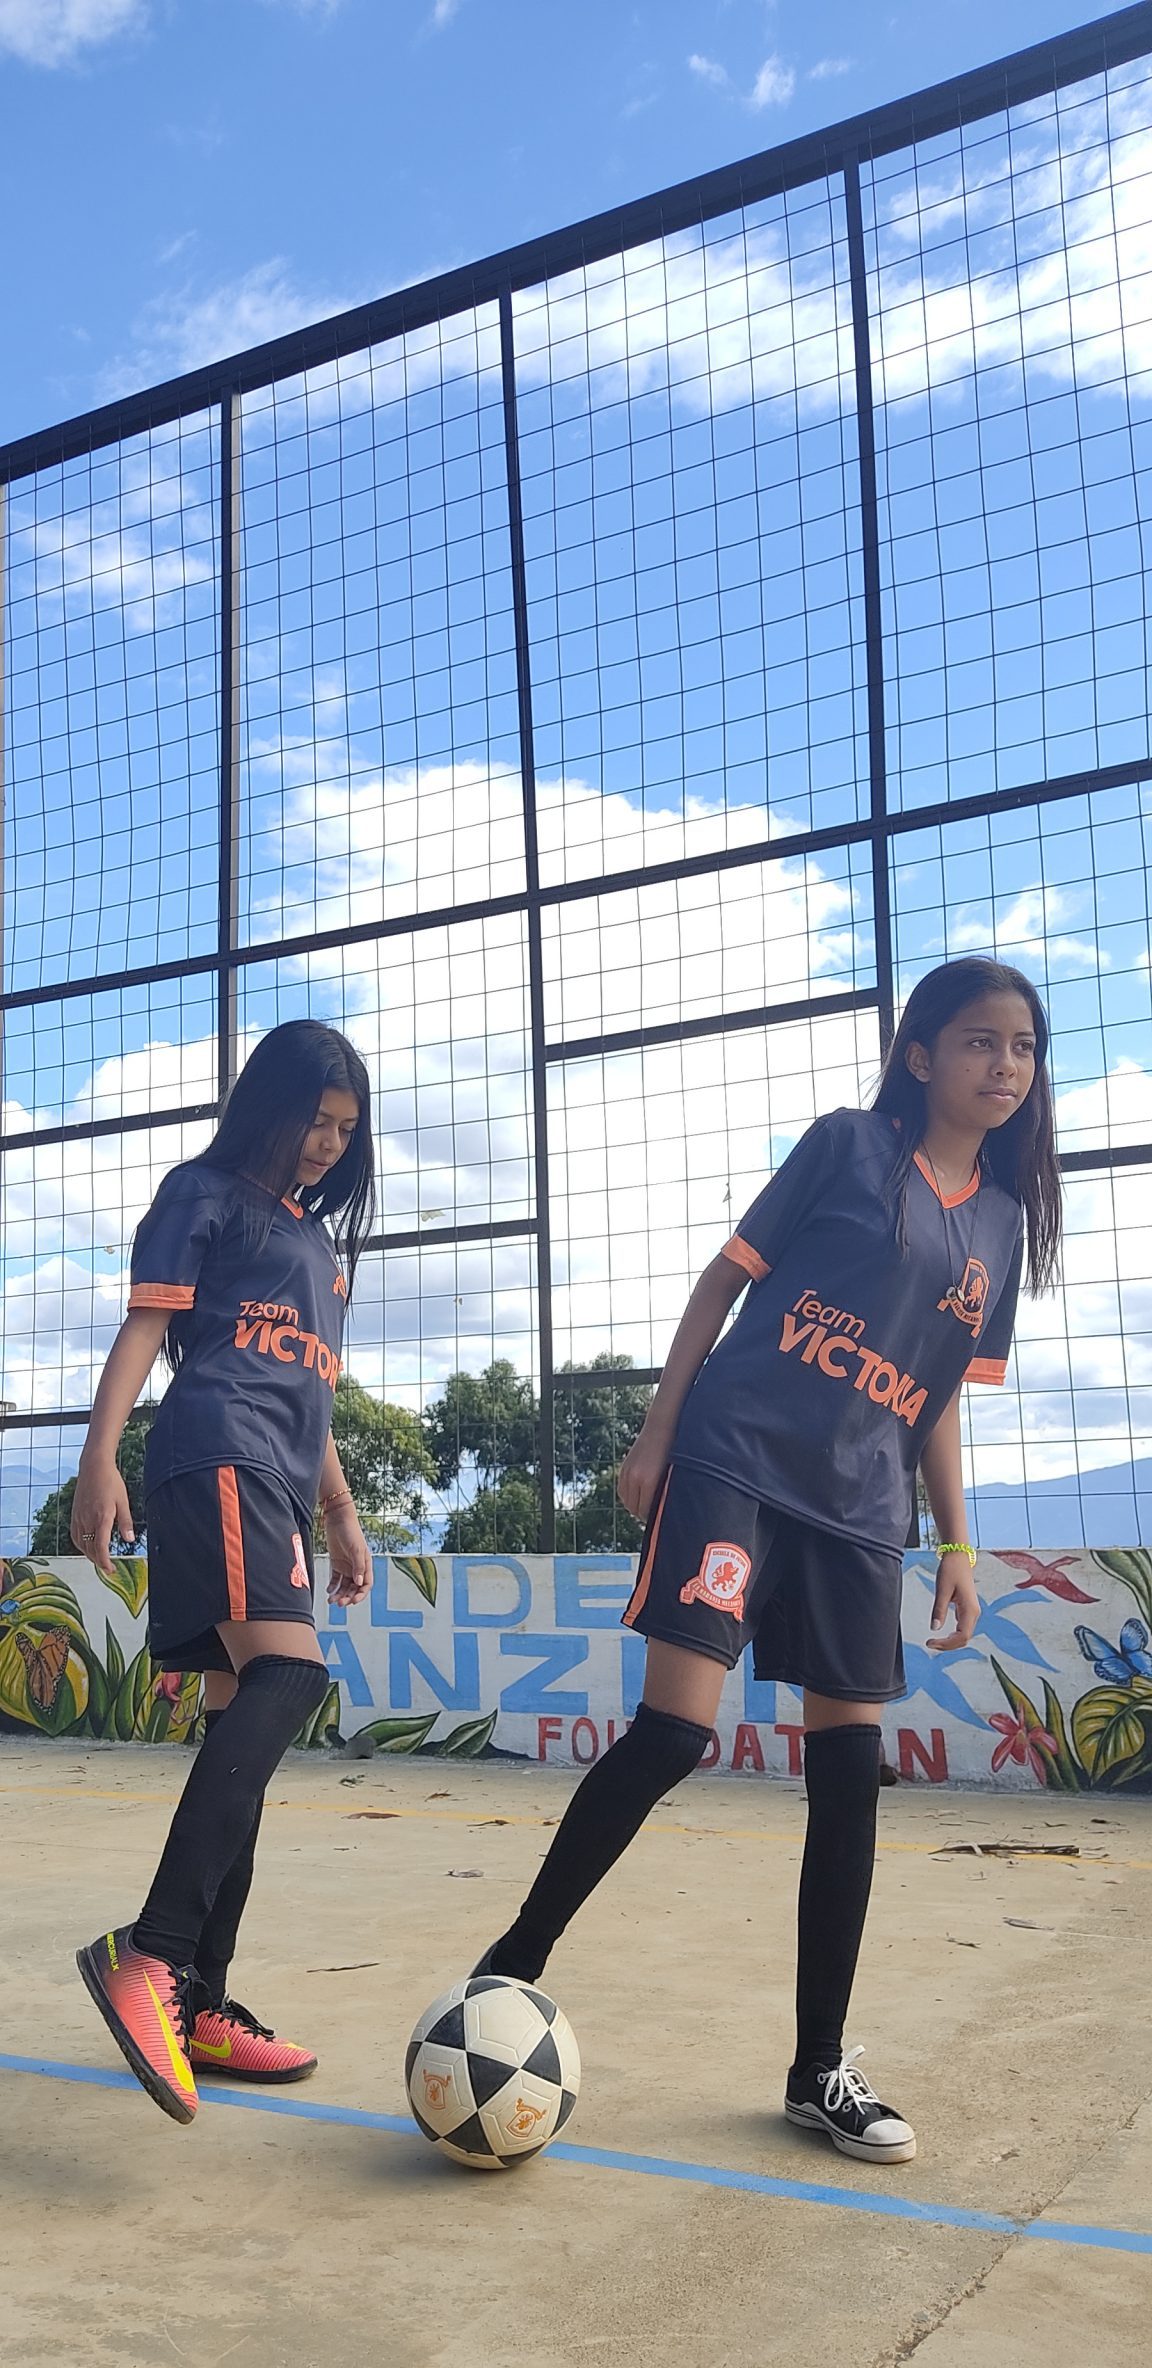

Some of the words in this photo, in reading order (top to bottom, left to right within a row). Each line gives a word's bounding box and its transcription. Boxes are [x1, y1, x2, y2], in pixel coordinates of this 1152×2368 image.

[240, 1300, 299, 1326] Team
[792, 1289, 866, 1338] Team
[234, 1319, 343, 1394] VICTOR
